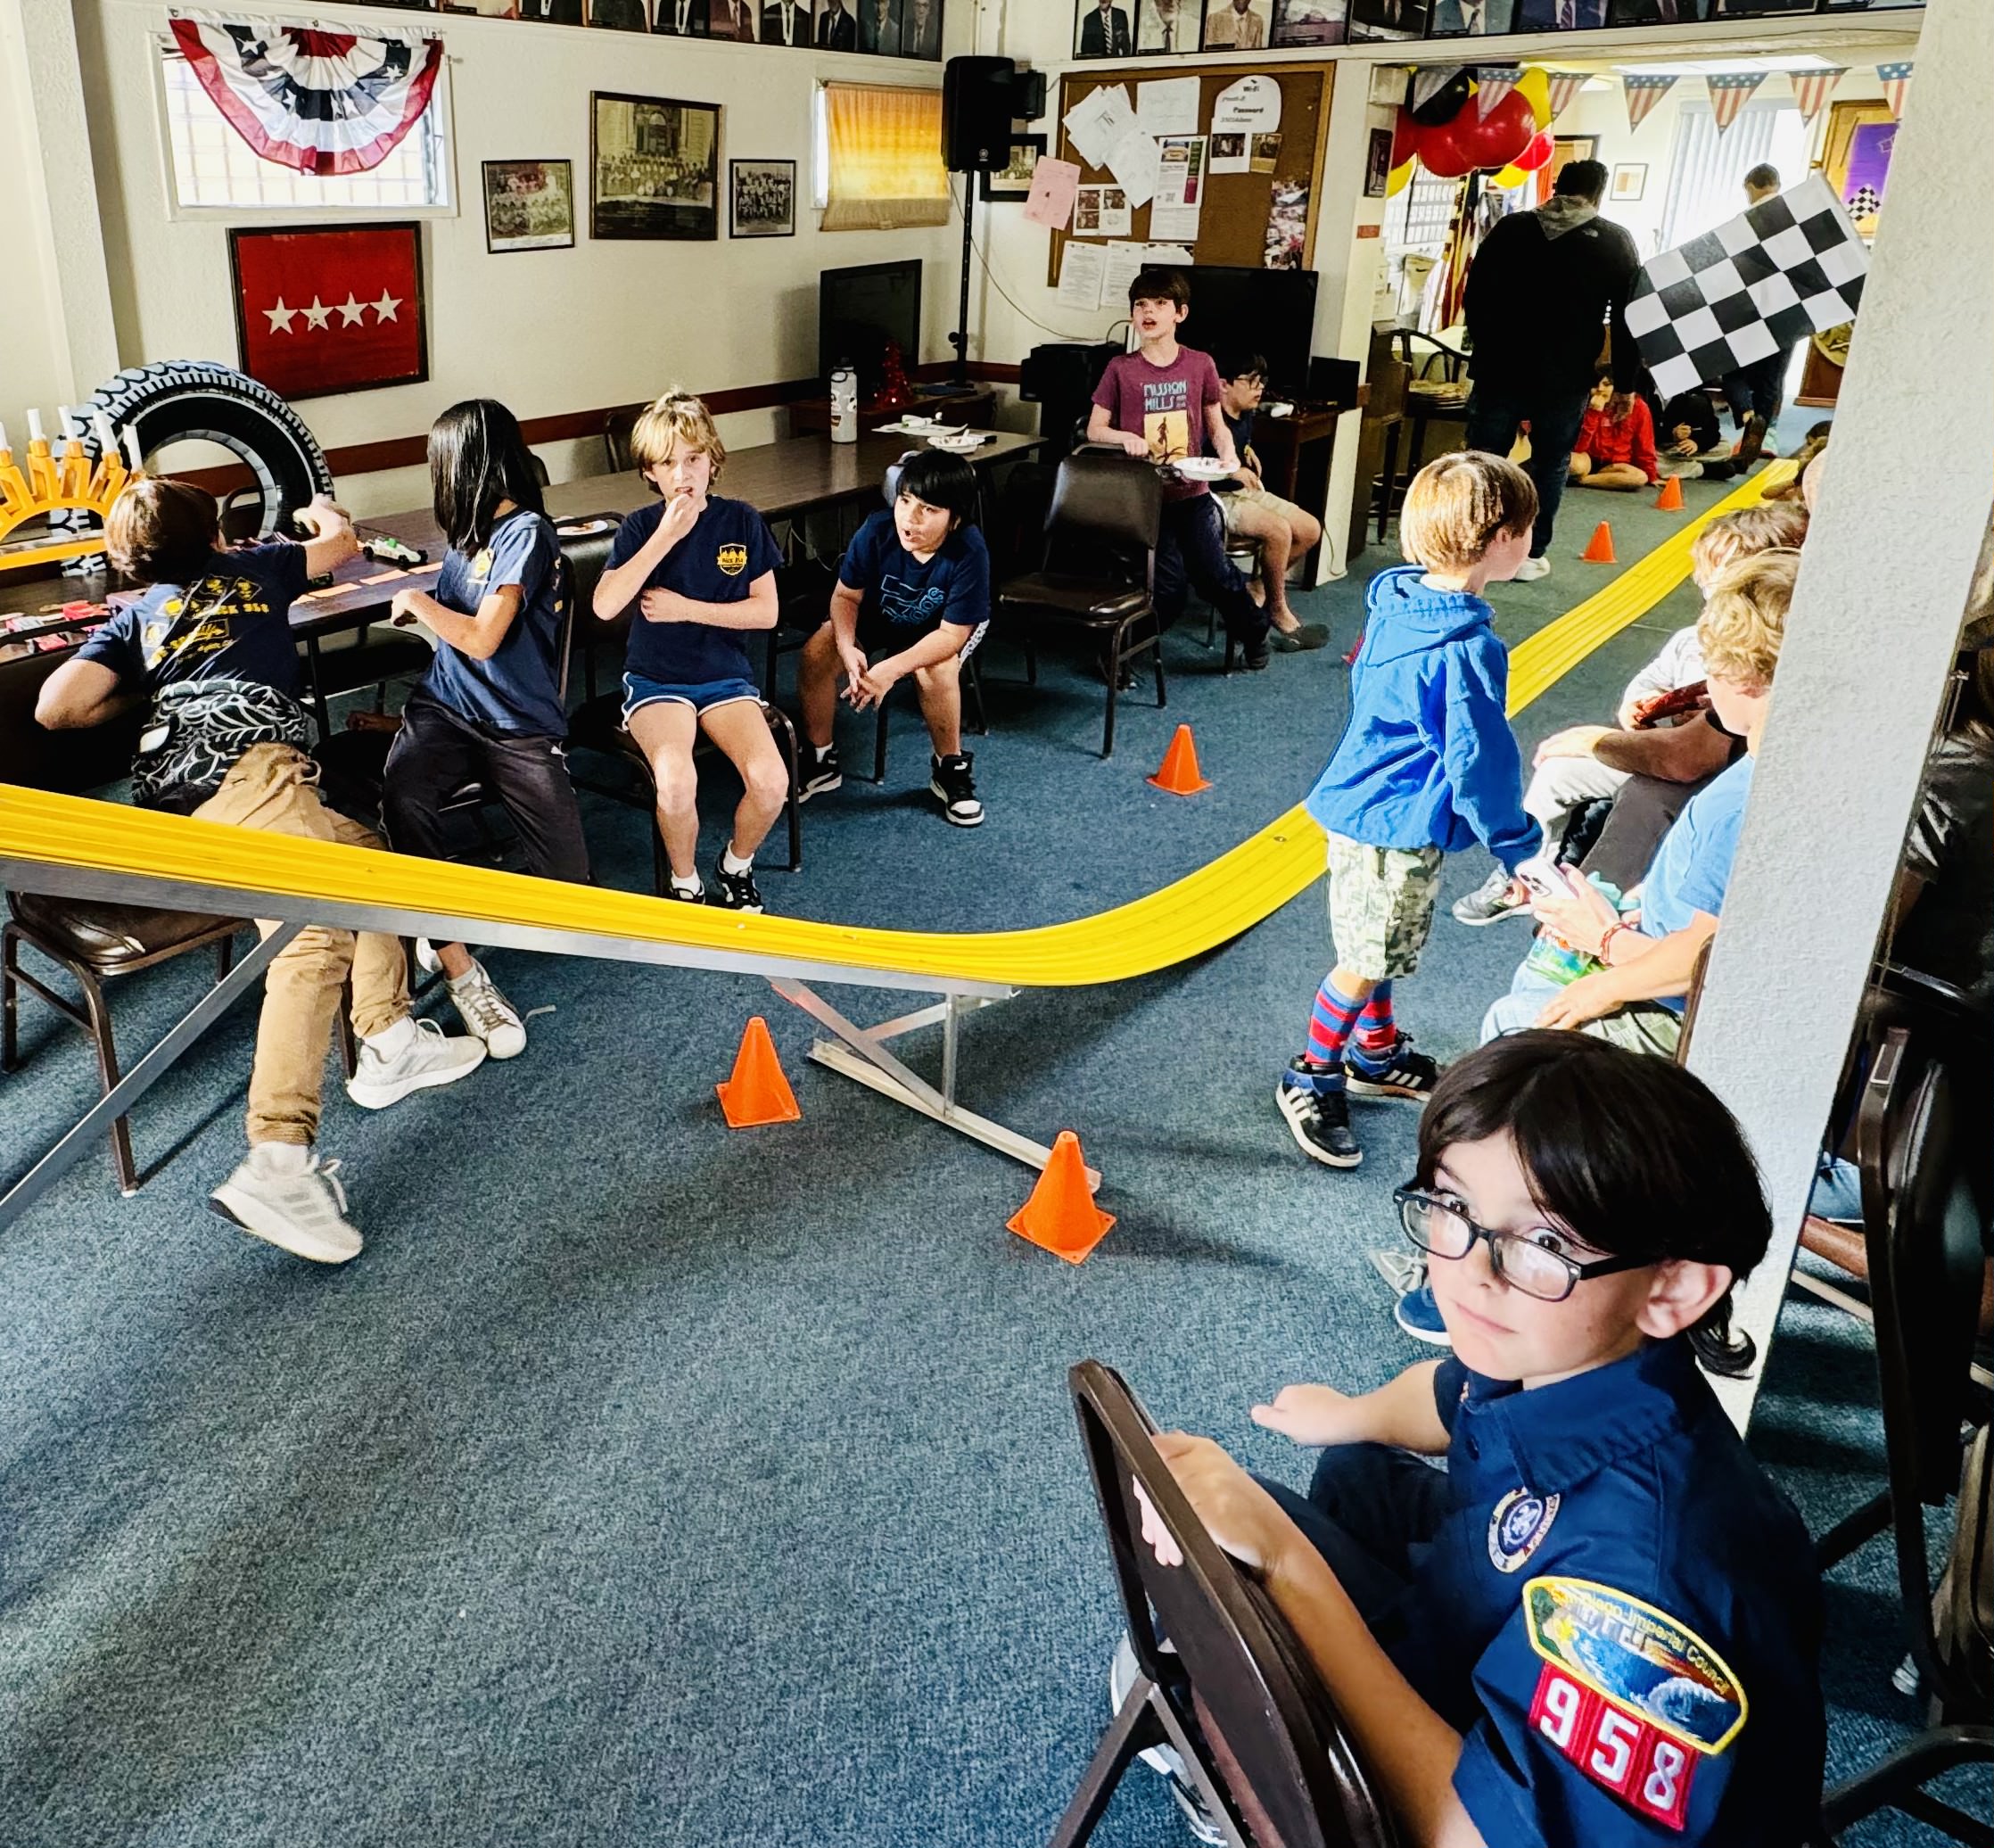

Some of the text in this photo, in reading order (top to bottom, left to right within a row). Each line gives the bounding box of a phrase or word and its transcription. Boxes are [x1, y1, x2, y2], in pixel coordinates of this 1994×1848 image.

[1232, 106, 1264, 114] Password
[1145, 395, 1174, 411] HILLS
[1539, 1678, 1685, 1811] 958
